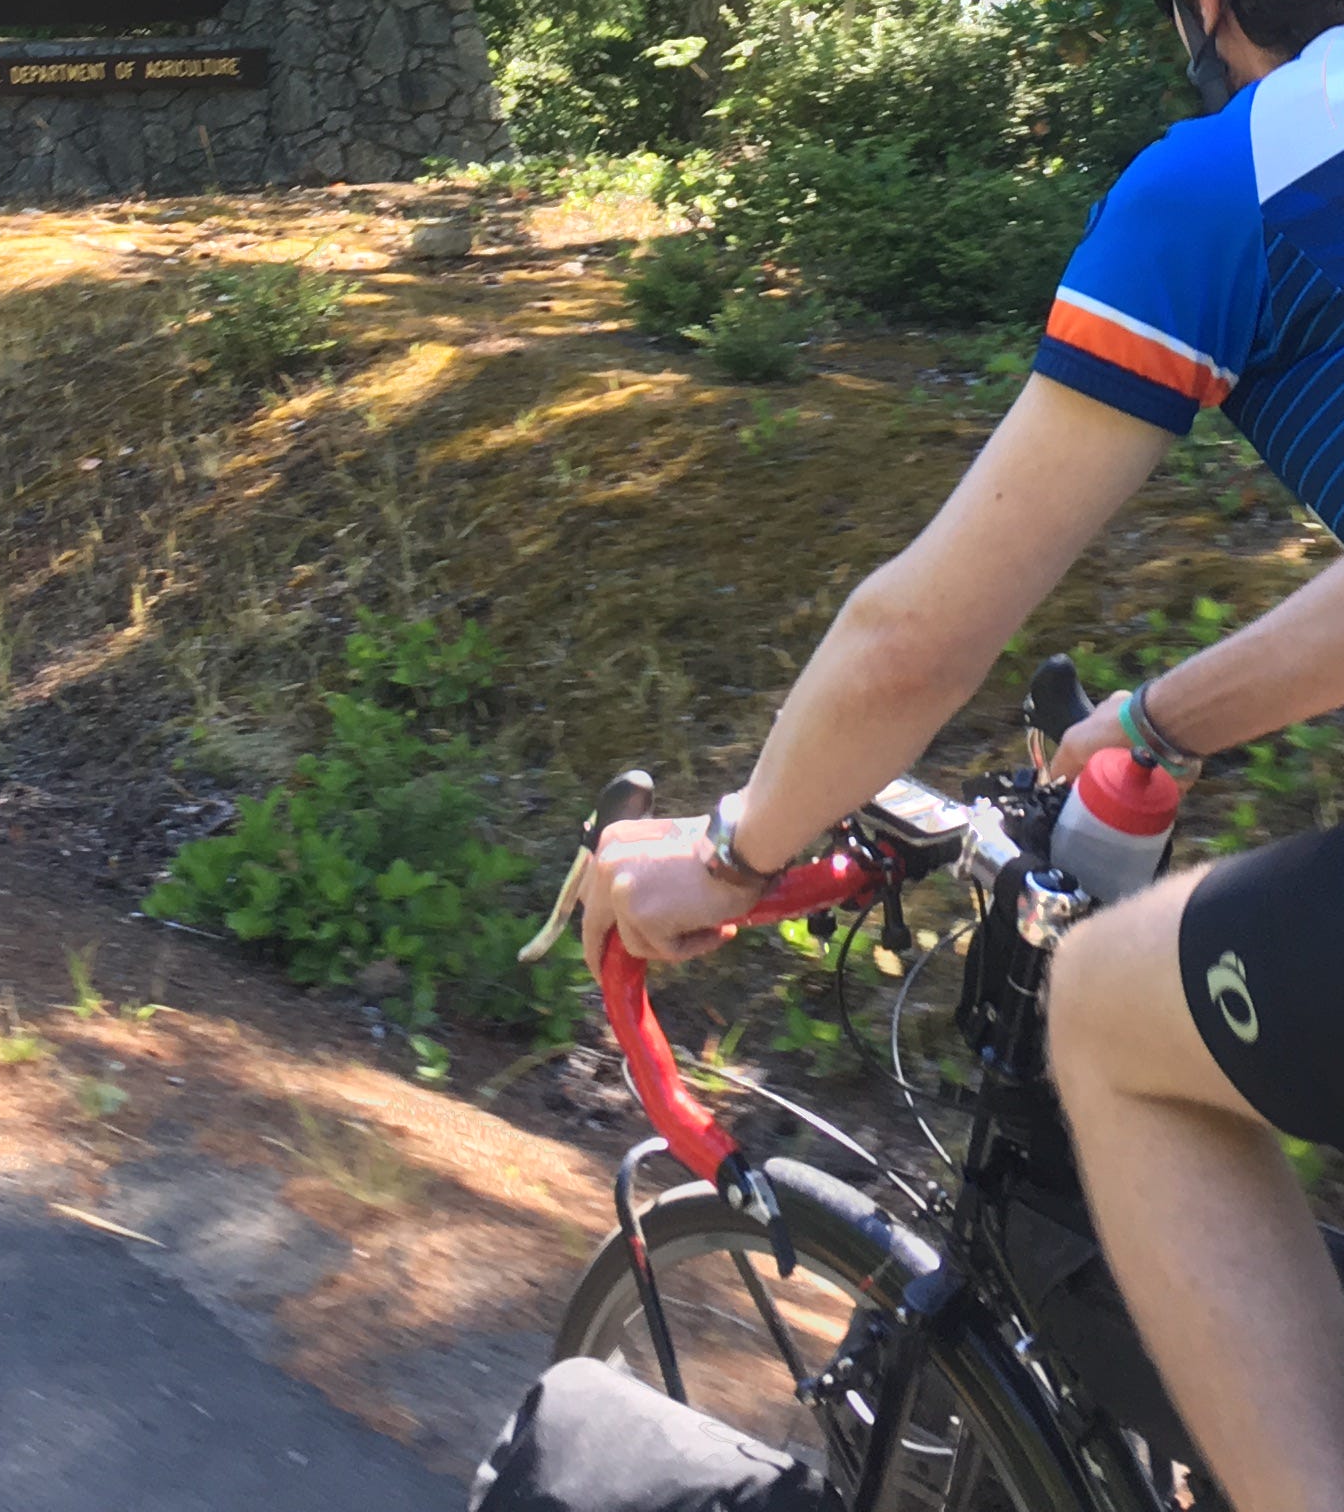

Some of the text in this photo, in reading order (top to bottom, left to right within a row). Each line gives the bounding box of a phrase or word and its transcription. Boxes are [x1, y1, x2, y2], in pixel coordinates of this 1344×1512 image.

[9, 61, 107, 85] DEPARTMENT
[114, 61, 136, 80] OF
[144, 57, 241, 79] AGRICULTURE
